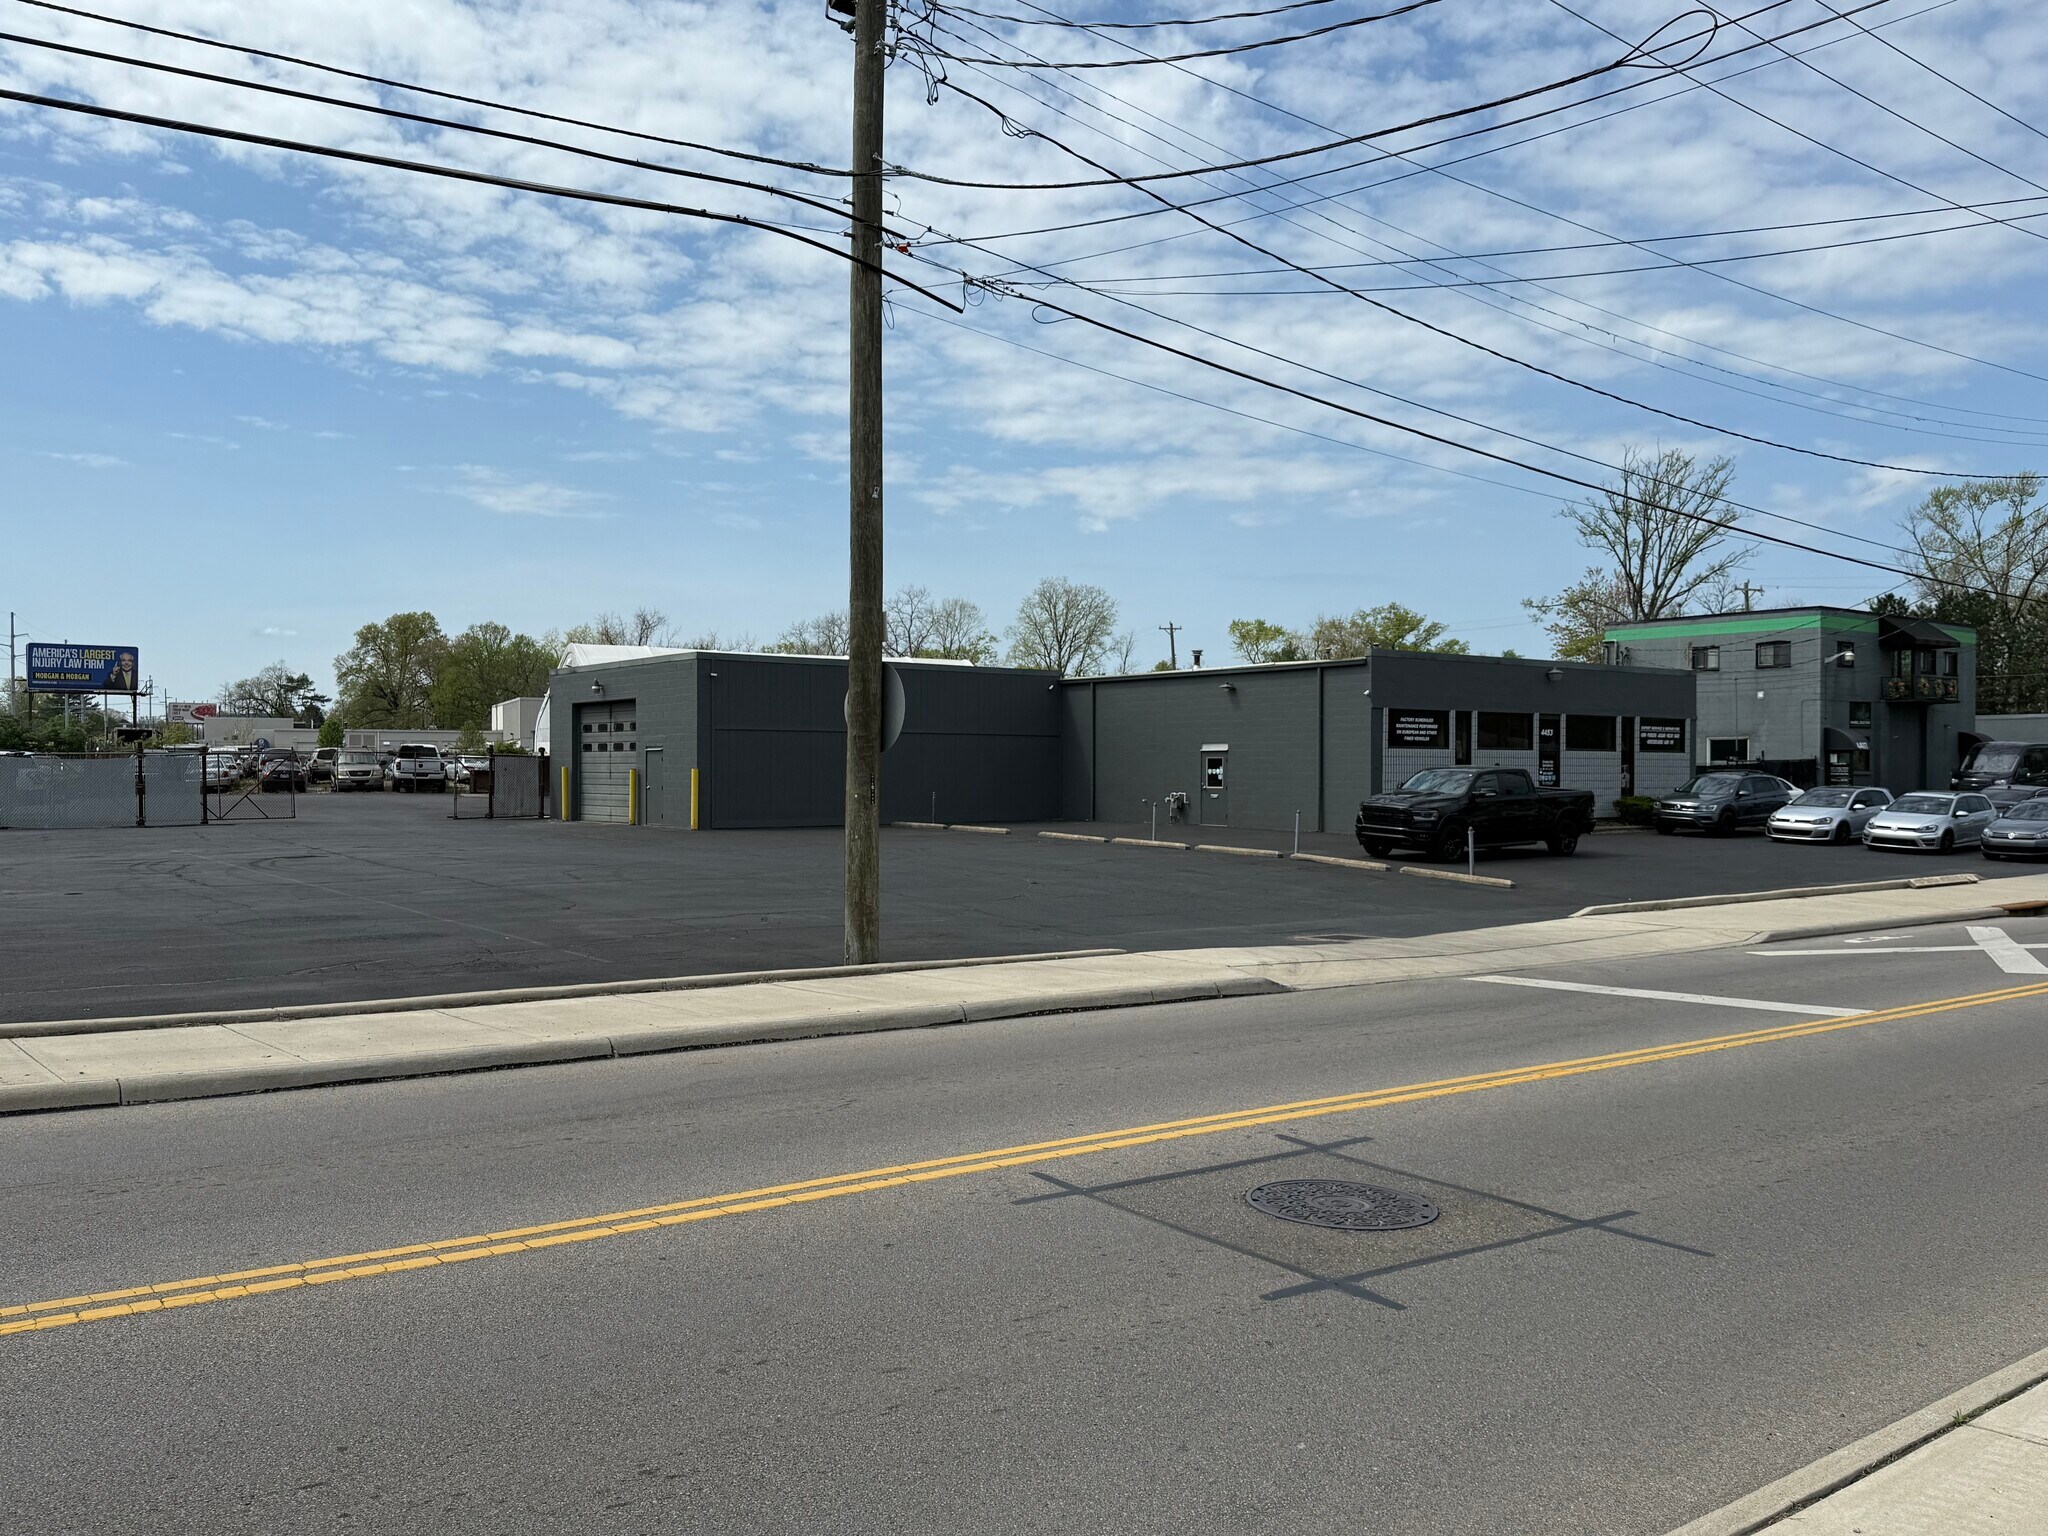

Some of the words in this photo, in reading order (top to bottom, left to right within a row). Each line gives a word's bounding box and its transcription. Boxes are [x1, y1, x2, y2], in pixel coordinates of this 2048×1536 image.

[32, 647, 78, 659] AMERICA'S
[79, 649, 116, 660] LARGEST
[32, 657, 63, 668] INJURY
[63, 658, 82, 669] LAW
[83, 659, 105, 669] FIRM
[35, 672, 59, 680] MORGAN
[60, 672, 65, 680] &
[65, 672, 90, 680] MORGAN
